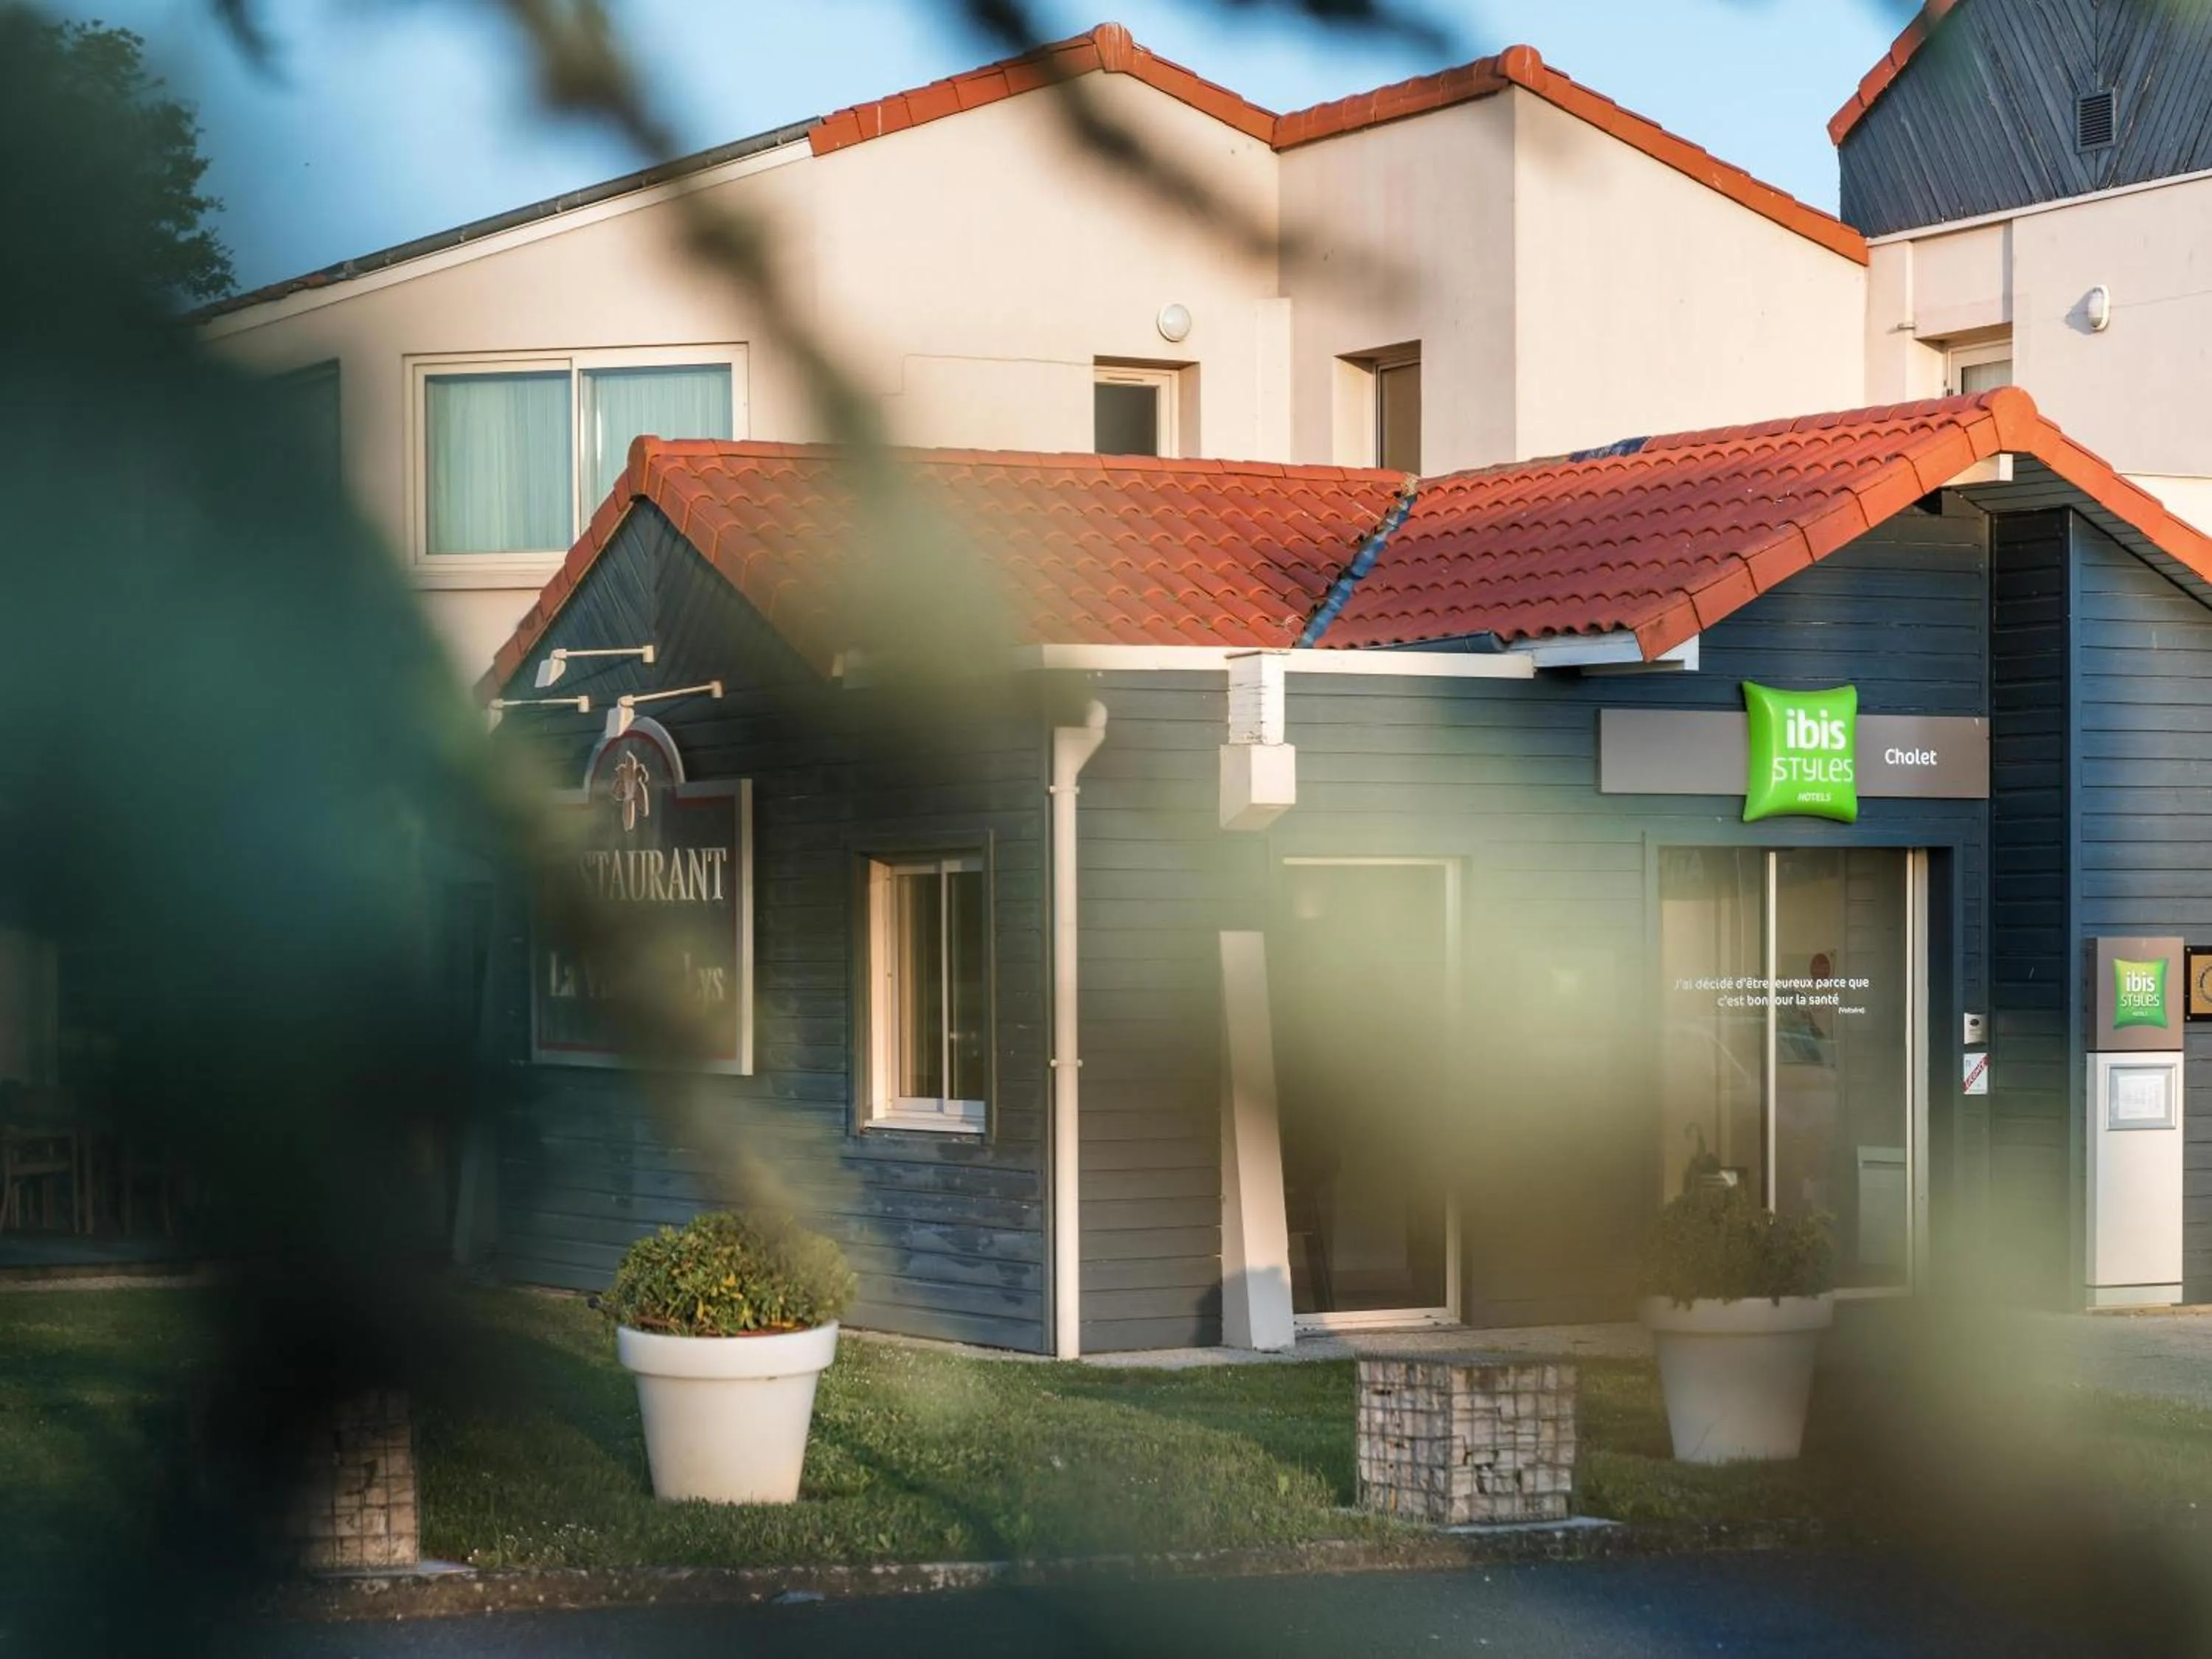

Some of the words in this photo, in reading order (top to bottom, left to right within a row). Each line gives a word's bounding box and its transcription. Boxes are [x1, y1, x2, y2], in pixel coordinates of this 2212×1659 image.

[1787, 708, 1846, 750] ibis
[1885, 748, 1938, 765] Cholet
[1797, 793, 1832, 802] HOTELS
[560, 847, 727, 901] STAURANT
[1695, 977, 1733, 990] décidé
[1735, 977, 1769, 989] d'être
[1770, 978, 1813, 989] eureux
[1815, 978, 1846, 990] parce
[1848, 978, 1869, 990] que
[2126, 970, 2156, 992] ibis
[1717, 995, 1745, 1007] c'est
[1747, 995, 1769, 1006] bon
[1770, 995, 1793, 1006] our
[1795, 993, 1806, 1006] la
[1809, 992, 1840, 1006] santé
